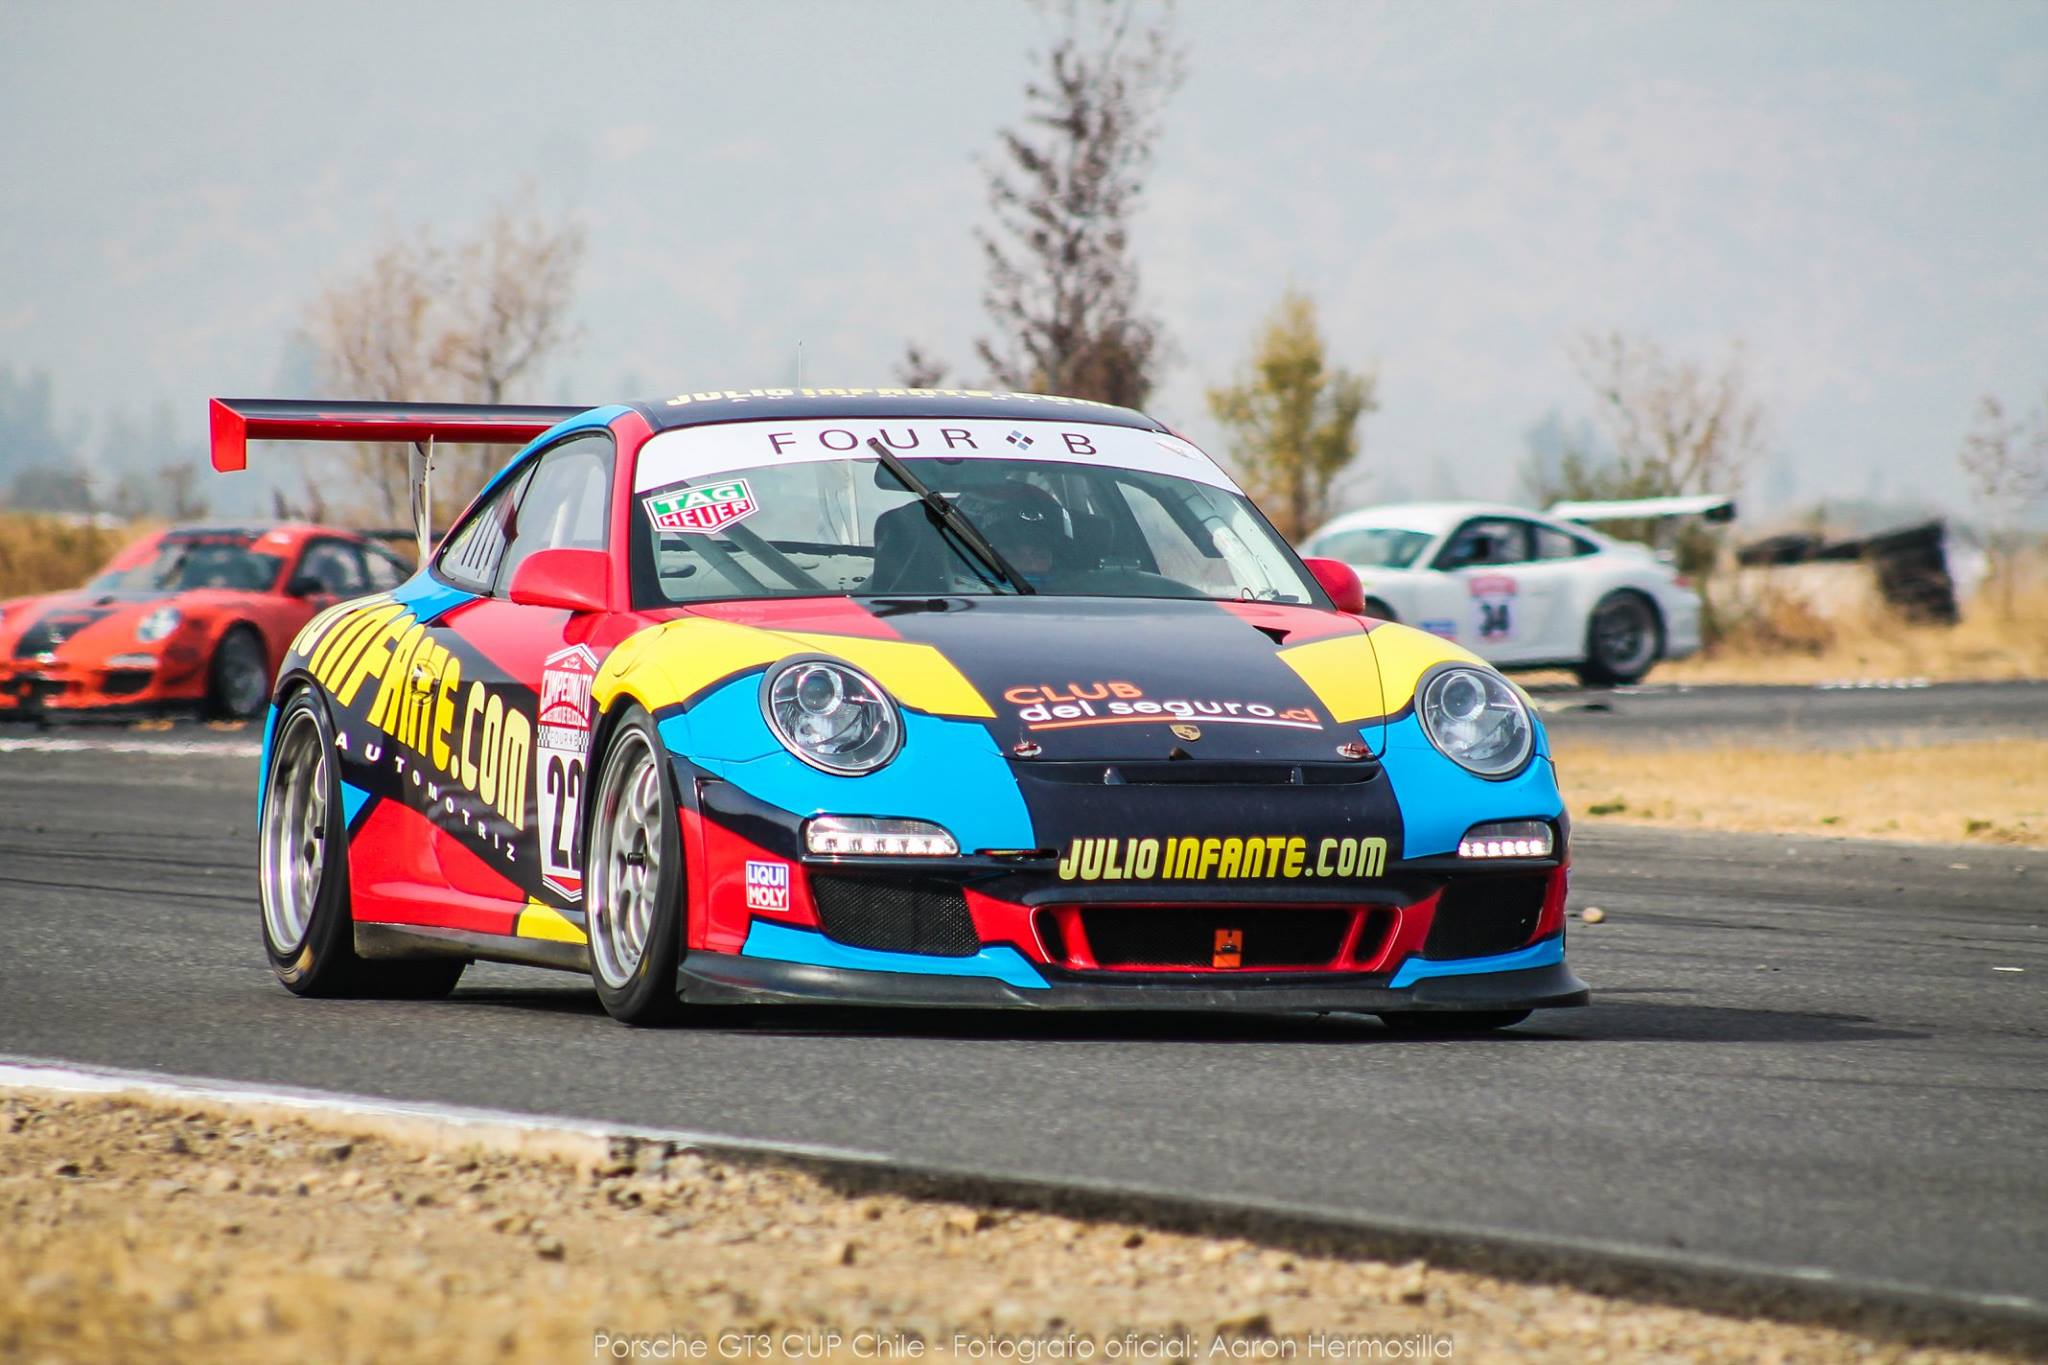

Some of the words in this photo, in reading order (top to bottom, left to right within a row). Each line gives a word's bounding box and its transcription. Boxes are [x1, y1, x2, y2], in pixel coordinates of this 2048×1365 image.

[768, 428, 979, 455] FOUR
[1061, 433, 1097, 455] B
[657, 486, 740, 511] TAG
[661, 501, 748, 527] HEUER
[1004, 682, 1143, 704] CLUB
[1019, 699, 1094, 722] del
[1108, 699, 1319, 722] seguro.cl
[335, 731, 516, 862] AUTOMOTRIZ
[547, 755, 583, 871] 22
[748, 885, 786, 907] MOLY
